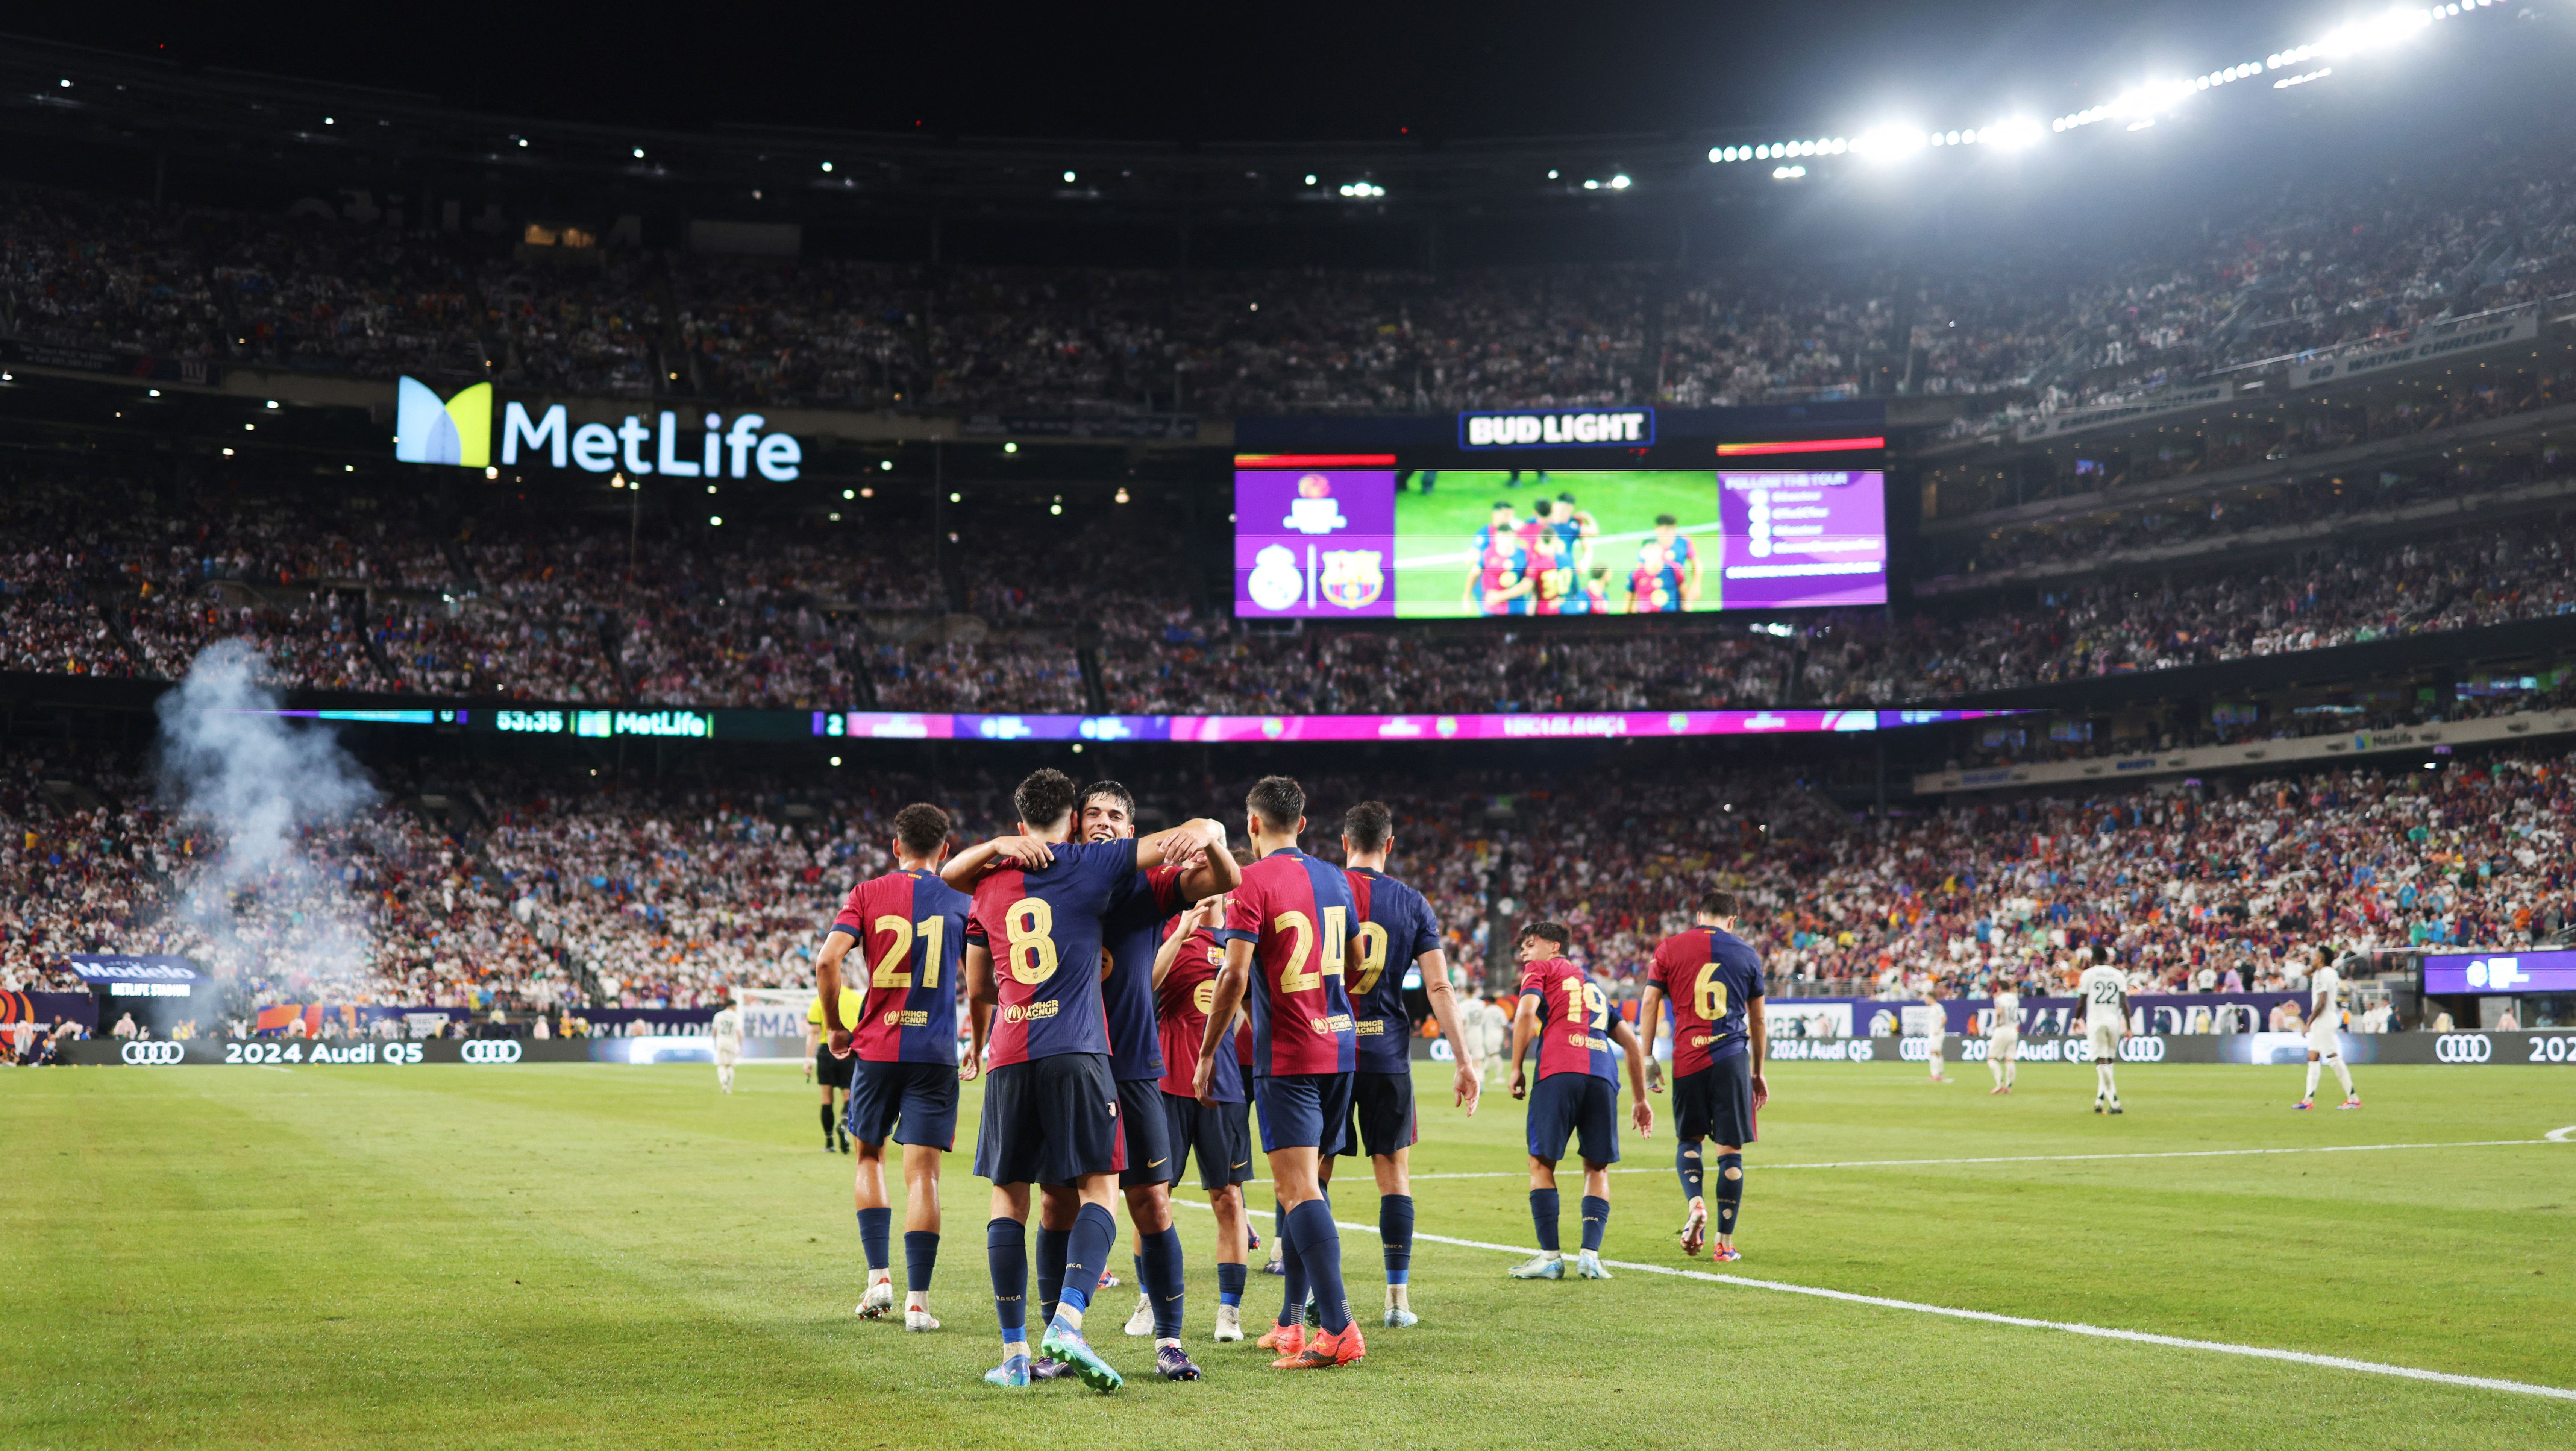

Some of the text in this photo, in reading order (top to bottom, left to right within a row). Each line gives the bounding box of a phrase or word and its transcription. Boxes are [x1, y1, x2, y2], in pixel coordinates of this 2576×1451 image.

[1469, 413, 1644, 445] BUD LIGHT
[502, 401, 802, 482] MetLife
[496, 710, 563, 733] 53:35
[614, 710, 706, 737] MetLife
[827, 713, 844, 736] 2
[2373, 732, 2413, 746] MetLife
[873, 915, 944, 988] 21
[1005, 897, 1058, 985] 8
[1274, 906, 1346, 993] 24
[1349, 921, 1388, 994] 9
[71, 961, 196, 979] Modelo
[111, 983, 191, 997] METLIFE STADIUM
[1694, 962, 1727, 1020] 6
[2094, 981, 2118, 1004] 22
[1025, 1007, 1058, 1017] ACNUR
[1562, 976, 1608, 1031] 19
[1325, 1014, 1350, 1023] UNHCR
[1330, 1021, 1353, 1030] ACNUR
[226, 1042, 423, 1065] 2024 Audi Q5
[1770, 1039, 1874, 1063] 2024 Audi Q5
[1961, 1039, 1991, 1061] 20
[2016, 1039, 2061, 1061] Audi
